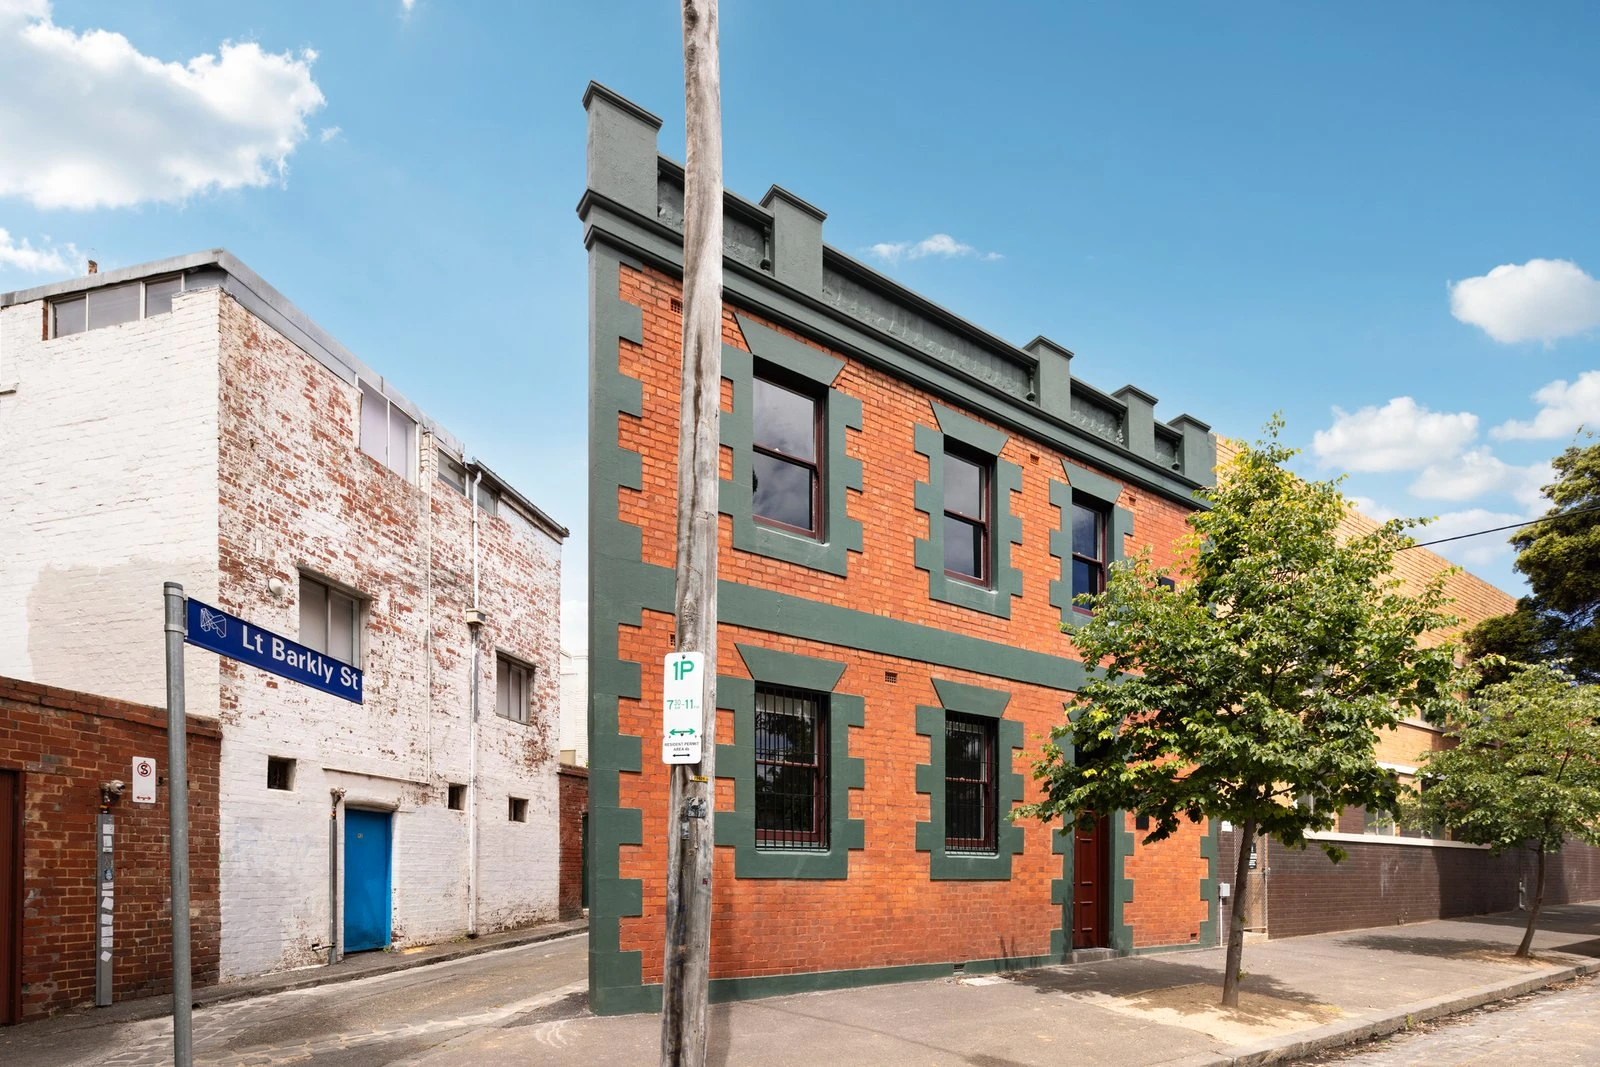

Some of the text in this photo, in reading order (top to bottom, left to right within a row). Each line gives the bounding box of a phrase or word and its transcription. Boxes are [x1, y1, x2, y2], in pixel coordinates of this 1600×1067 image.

[242, 625, 359, 690] Lt Barkly St
[673, 660, 695, 681] 1P
